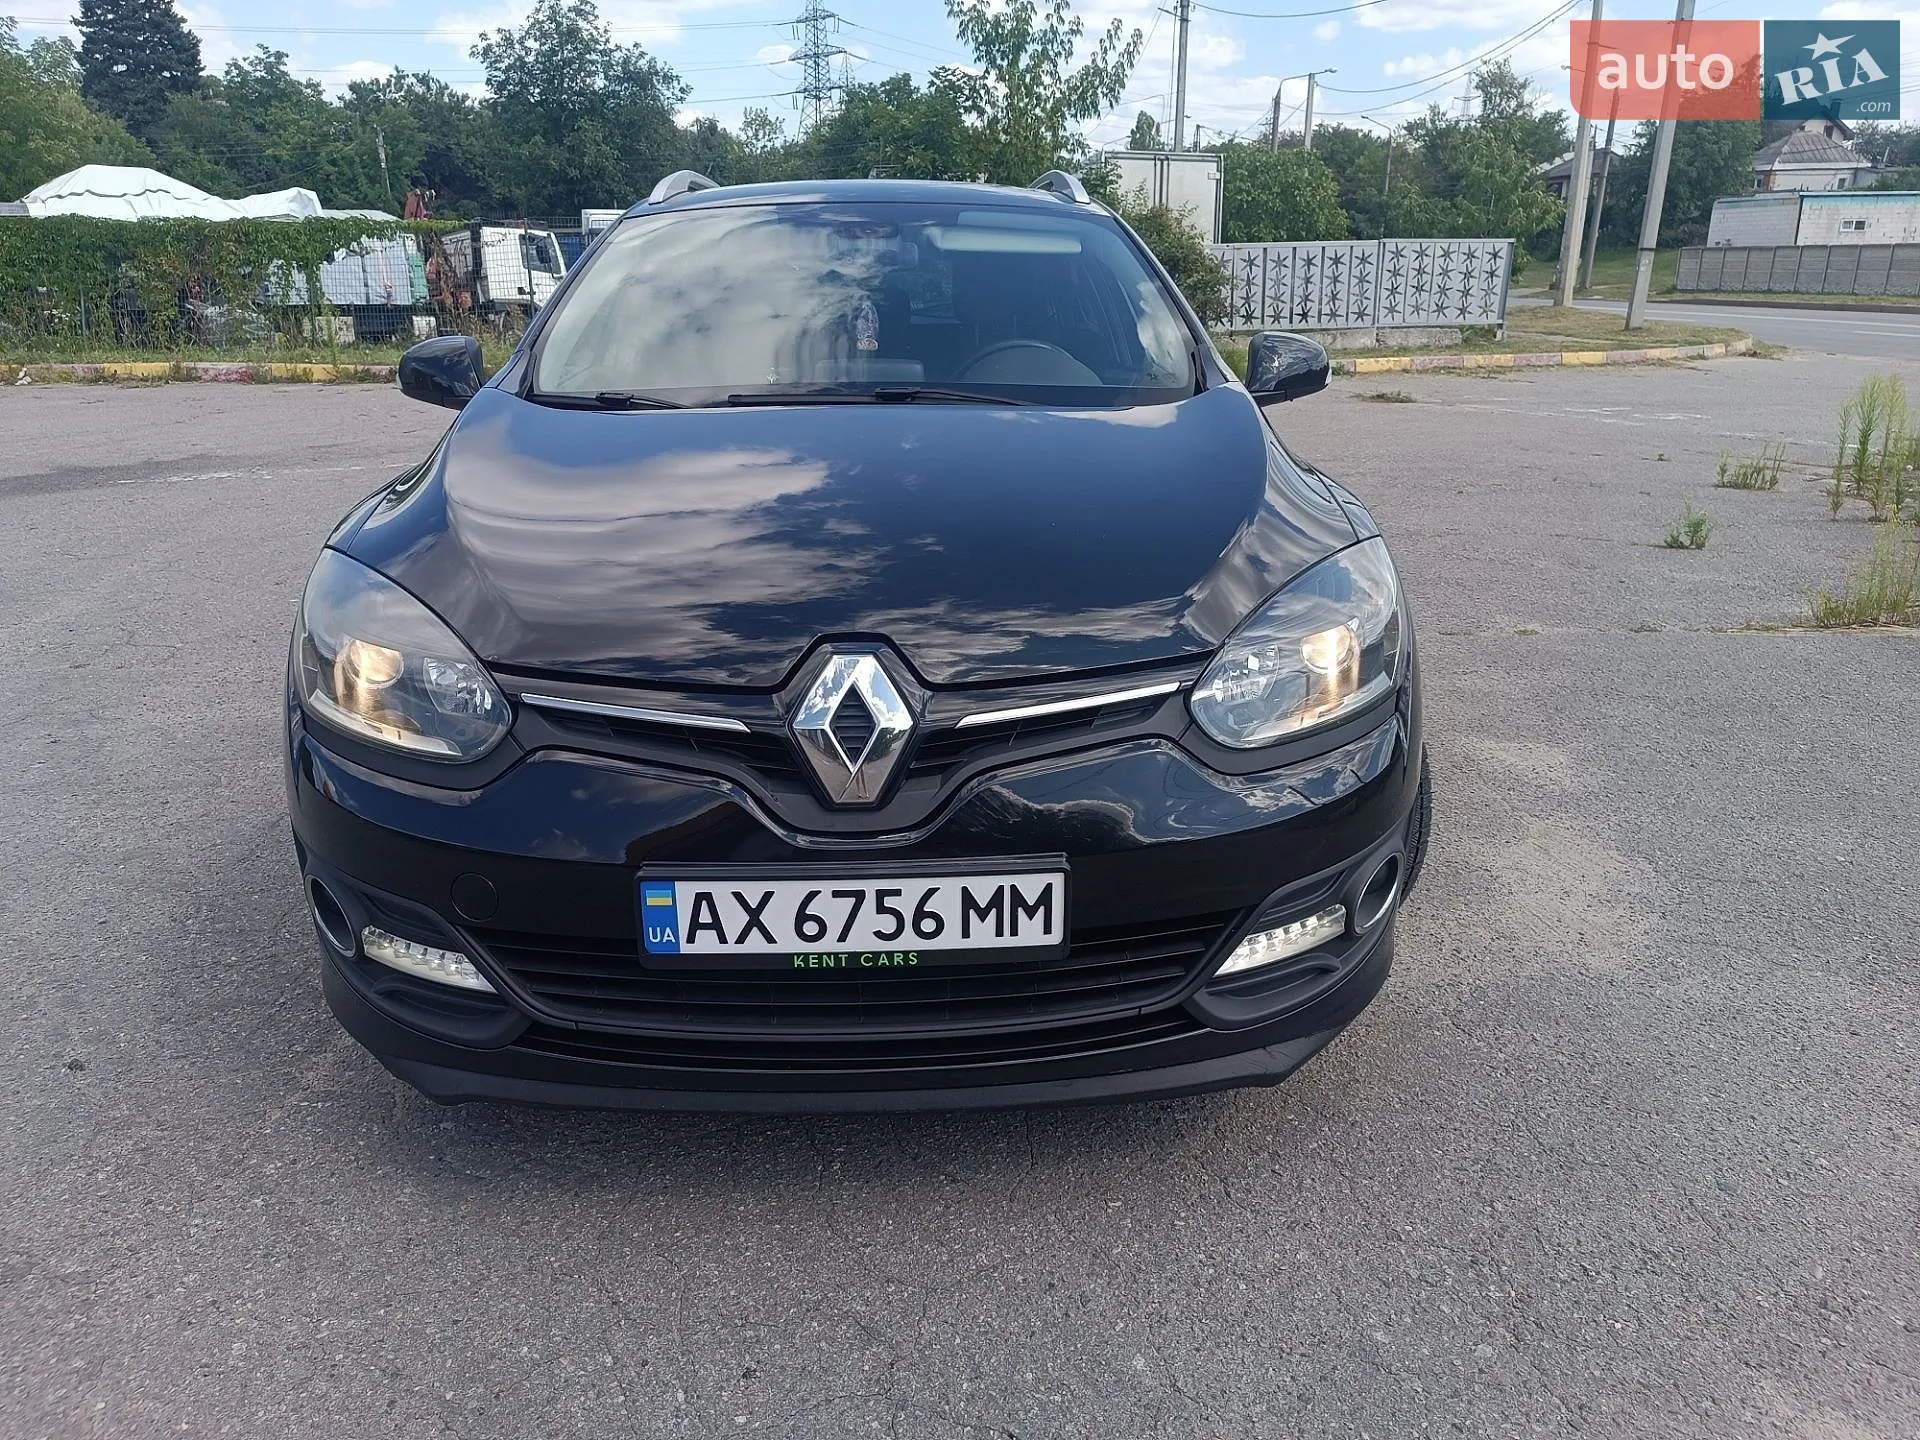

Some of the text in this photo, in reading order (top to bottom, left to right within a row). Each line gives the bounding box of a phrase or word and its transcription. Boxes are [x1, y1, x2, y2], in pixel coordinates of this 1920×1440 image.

[686, 882, 1053, 945] AX 6756 MM
[648, 927, 676, 943] UA
[793, 952, 919, 968] KENT CARS
